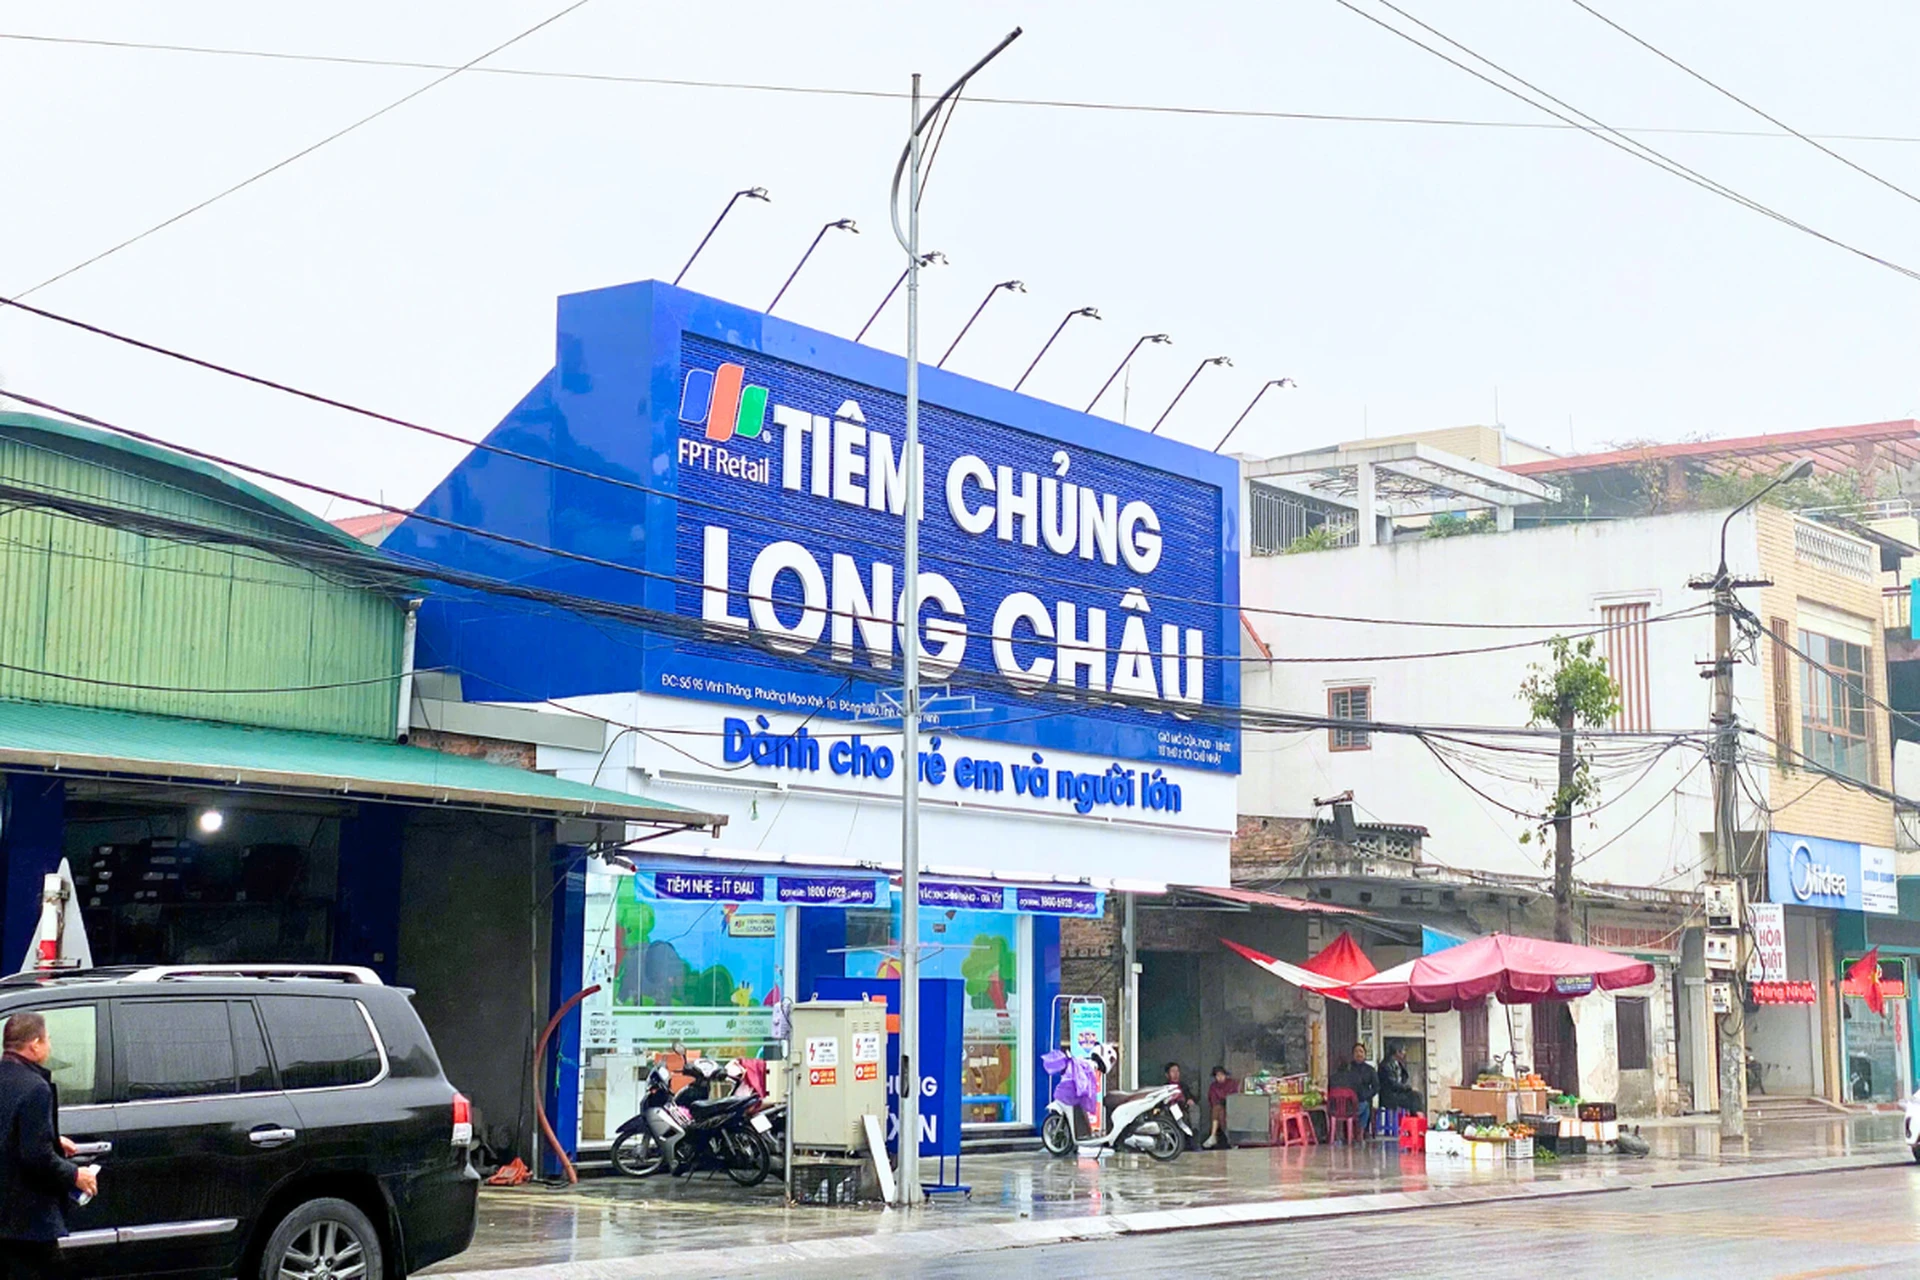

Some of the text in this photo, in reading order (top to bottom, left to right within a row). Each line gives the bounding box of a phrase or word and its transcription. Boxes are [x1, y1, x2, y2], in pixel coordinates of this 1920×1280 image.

[678, 438, 770, 485] FPT Retail
[774, 400, 1163, 574] TIÊM CHỦNG
[702, 525, 1204, 720] LONG CHÂU
[723, 714, 820, 772] Dành
[828, 734, 895, 780] cho
[954, 756, 1004, 793] em
[1011, 752, 1049, 798] và
[1056, 762, 1135, 814] người
[1141, 768, 1183, 813] lớn
[666, 875, 691, 894] TIÊM
[692, 878, 714, 898] NHẸ
[721, 878, 732, 894] ÍT
[733, 880, 755, 895] ĐAU
[1790, 839, 1848, 901] Midea
